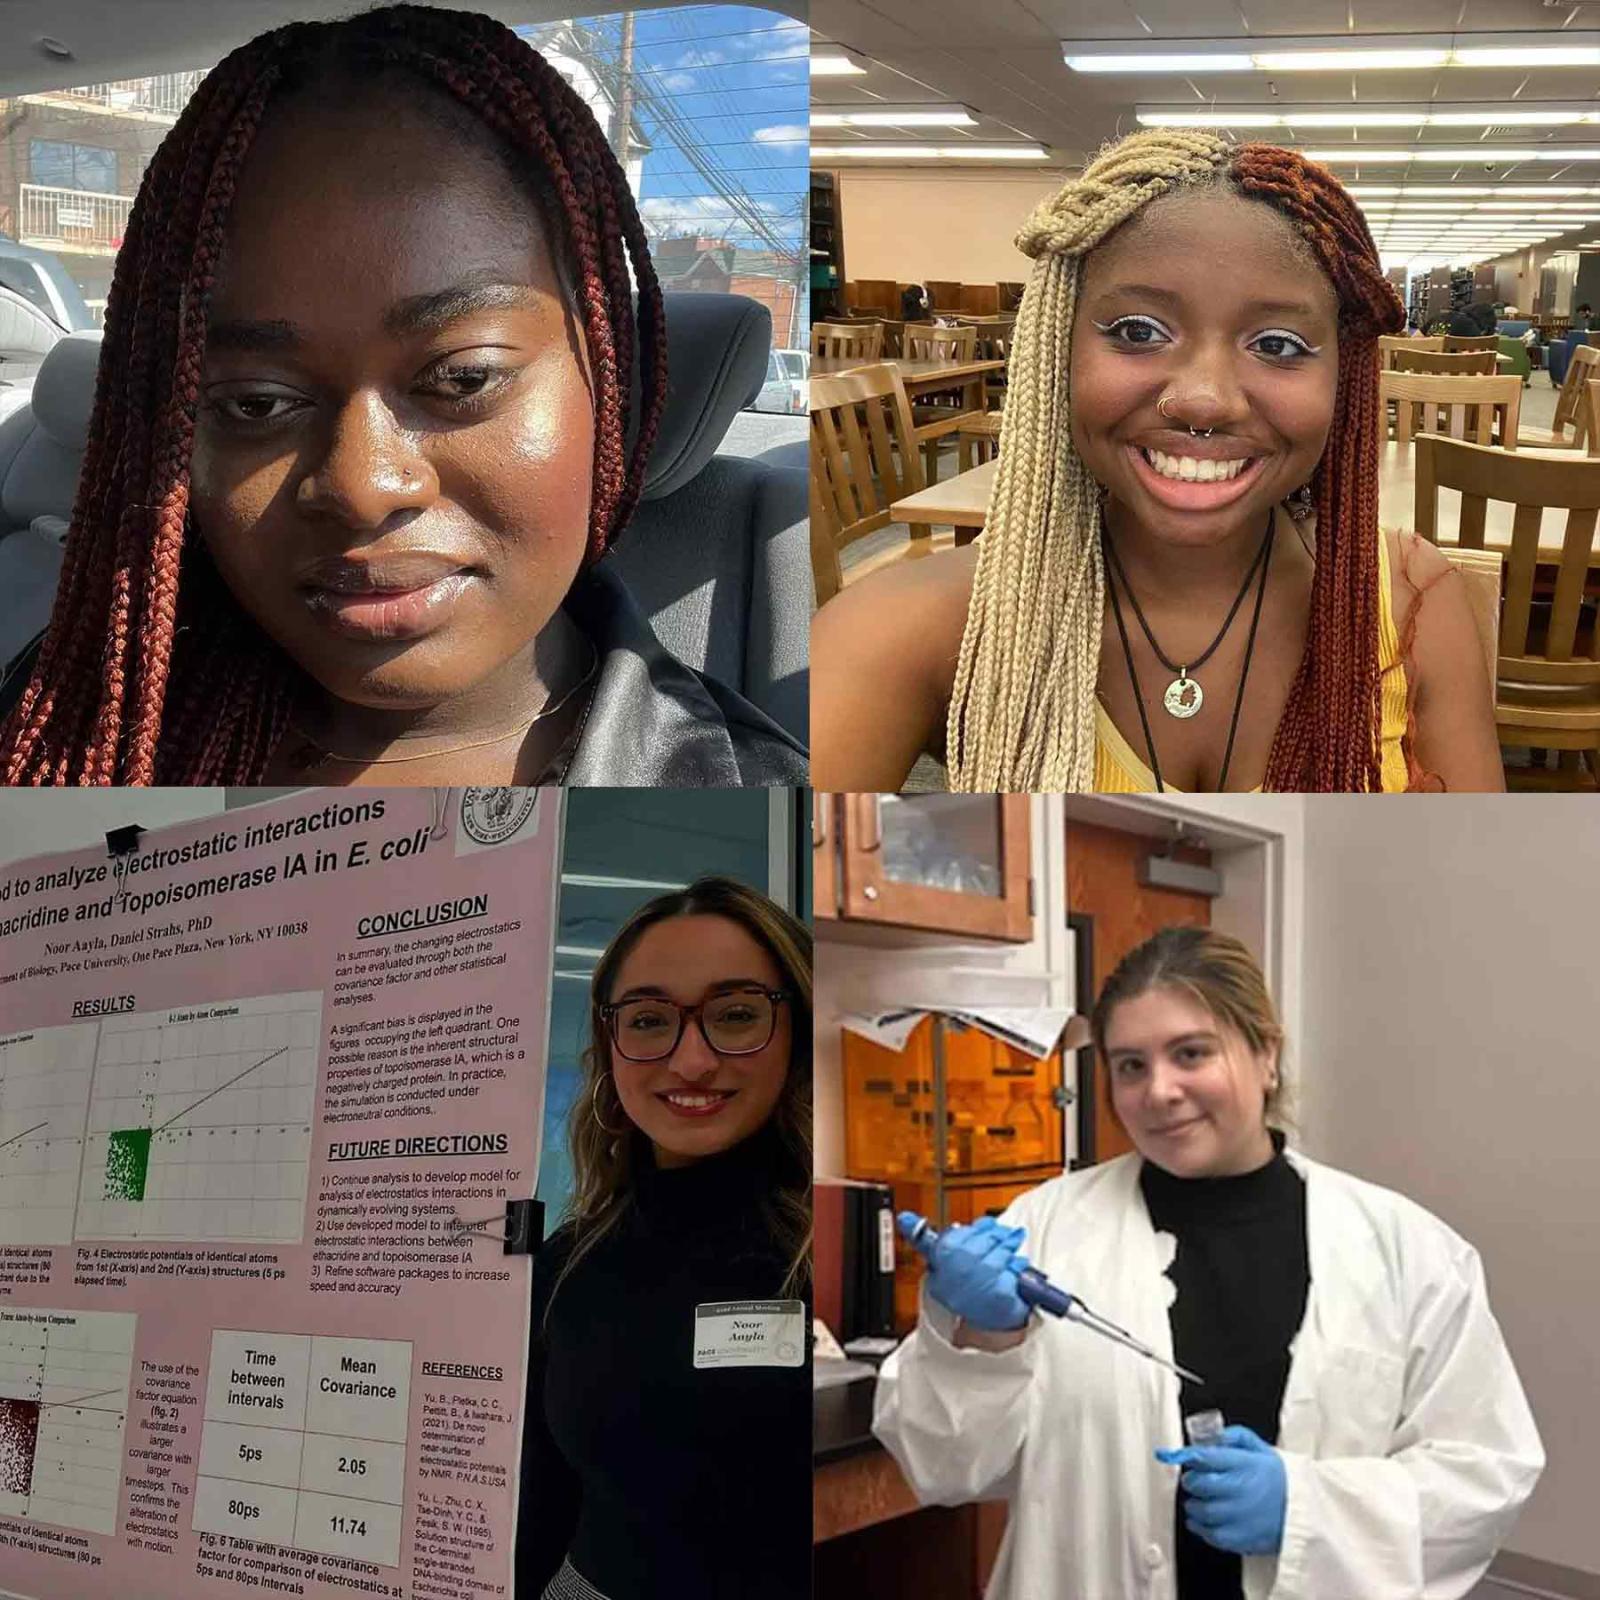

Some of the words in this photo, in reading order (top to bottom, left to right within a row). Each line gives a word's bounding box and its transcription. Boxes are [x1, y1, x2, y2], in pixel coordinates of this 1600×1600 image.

[0, 880, 10, 901] d
[15, 880, 29, 897] to
[35, 865, 107, 893] analyze
[114, 834, 237, 877] electrostatic
[245, 800, 385, 848] interactions
[75, 899, 112, 920] and
[120, 867, 276, 914] Topoisomerase
[284, 854, 306, 878] IA
[315, 850, 336, 873] in
[347, 841, 370, 867] E.
[381, 827, 430, 861] coli
[357, 894, 488, 935] CONCLUSION
[44, 942, 70, 957] Noor
[110, 927, 143, 946] Daniel
[147, 921, 183, 940] Strahs,
[187, 916, 212, 934] PhD
[394, 944, 409, 953] the
[411, 934, 453, 950] changing
[456, 920, 521, 942] electrostatics
[60, 957, 81, 972] Pace
[132, 952, 150, 964] One
[152, 948, 172, 960] Pace
[204, 937, 224, 952] New
[257, 926, 274, 940] NY
[277, 922, 308, 936] 10038
[335, 967, 352, 976] can
[355, 963, 366, 974] be
[368, 957, 413, 973] evaluated
[416, 950, 450, 964] through
[453, 945, 474, 957] both
[477, 941, 492, 951] the
[334, 977, 384, 991] covariance
[386, 972, 411, 984] factor
[414, 966, 432, 980] and
[434, 962, 456, 976] other
[460, 953, 507, 970] statistical
[72, 995, 135, 1016] RESULTS
[331, 1025, 338, 1035] A
[340, 1019, 384, 1037] significant
[387, 1016, 405, 1028] bias
[418, 1009, 461, 1026] displayed
[464, 1007, 472, 1017] in
[476, 1004, 492, 1015] the
[365, 1033, 410, 1049] occupying
[412, 1030, 426, 1040] the
[497, 1017, 520, 1028] One
[328, 1052, 365, 1066] possible
[367, 1050, 398, 1061] reason
[410, 1045, 424, 1055] the
[427, 1040, 466, 1053] inherent
[469, 1034, 518, 1048] structural
[327, 1066, 372, 1081] properties
[374, 1063, 383, 1075] of
[385, 1057, 450, 1075] topoisomerase
[472, 1051, 502, 1063] which
[506, 1050, 514, 1060] is
[518, 1050, 525, 1059] a
[326, 1080, 370, 1094] negatively
[373, 1077, 408, 1091] charged
[449, 1070, 458, 1081] In
[341, 1094, 384, 1107] simulation
[397, 1089, 445, 1102] conducted
[449, 1086, 480, 1097] under
[323, 1108, 382, 1123] electroneutral
[329, 1139, 390, 1158] FUTURE
[395, 1134, 508, 1154] DIRECTIONS
[372, 1172, 409, 1185] analysis
[412, 1173, 422, 1182] to
[425, 1172, 466, 1184] develop
[470, 1171, 503, 1181] model
[506, 1170, 520, 1180] for
[319, 1189, 353, 1201] analysis
[355, 1189, 364, 1199] of
[366, 1187, 428, 1199] electrostatics
[432, 1186, 493, 1198] interactions
[496, 1186, 506, 1197] in
[318, 1203, 367, 1217] dynamically
[370, 1203, 408, 1216] evolving
[327, 1220, 344, 1231] Use
[346, 1220, 393, 1232] developed
[396, 1220, 427, 1230] model
[430, 1220, 440, 1230] to
[315, 1235, 366, 1246] electrostatic
[368, 1235, 424, 1247] interactions
[428, 1236, 473, 1247] between
[150, 1251, 193, 1262] potentials
[196, 1252, 204, 1261] of
[249, 1253, 278, 1263] atoms
[362, 1251, 380, 1262] and
[382, 1252, 459, 1264] topoisomerase
[76, 1262, 93, 1273] from
[142, 1264, 155, 1273] and
[212, 1266, 260, 1278] structures
[325, 1267, 353, 1277] Refine
[355, 1267, 396, 1278] software
[398, 1268, 449, 1281] packages
[452, 1270, 461, 1279] to
[465, 1270, 509, 1281] increase
[74, 1275, 104, 1287] elapsed
[310, 1282, 336, 1293] speed
[338, 1283, 355, 1293] and
[357, 1284, 400, 1295] accuracy
[733, 1321, 763, 1329] Noor
[246, 1350, 276, 1366] Time
[341, 1357, 376, 1374] Mean
[141, 1361, 157, 1372] The
[158, 1364, 174, 1373] use
[176, 1364, 184, 1374] of
[186, 1366, 199, 1376] the
[422, 1362, 503, 1378] REFERENCES
[146, 1378, 191, 1389] covariance
[231, 1370, 285, 1387] between
[320, 1377, 397, 1398] Covariance
[136, 1390, 159, 1401] factor
[161, 1393, 197, 1405] equation
[228, 1390, 284, 1409] intervals
[467, 1424, 486, 1432] novo
[421, 1430, 476, 1444] determination
[129, 1449, 173, 1462] covariance
[239, 1445, 262, 1461] 5ps
[338, 1457, 366, 1474] 2.05
[421, 1456, 467, 1469] electrostatic
[130, 1493, 166, 1506] confirms
[229, 1500, 259, 1520] 80ps
[126, 1522, 178, 1539] electrostatics
[330, 1517, 366, 1536] 11.74
[23, 1526, 31, 1534] of
[65, 1535, 88, 1546] atoms
[415, 1530, 447, 1541] Solution
[450, 1537, 484, 1550] structure
[38, 1544, 75, 1559] structures
[91, 1556, 101, 1565] ps
[229, 1537, 253, 1552] Table
[256, 1543, 276, 1556] with
[279, 1549, 318, 1565] average
[322, 1556, 379, 1575] covariance
[196, 1564, 213, 1576] 5ps
[216, 1568, 234, 1580] and
[236, 1571, 258, 1586] 80ps
[199, 1549, 225, 1561] factor
[228, 1553, 241, 1565] for
[244, 1559, 300, 1576] comparison
[304, 1569, 315, 1580] of
[317, 1573, 389, 1595] electrostatics
[392, 1586, 402, 1598] at
[413, 1568, 463, 1587] DNA-binding
